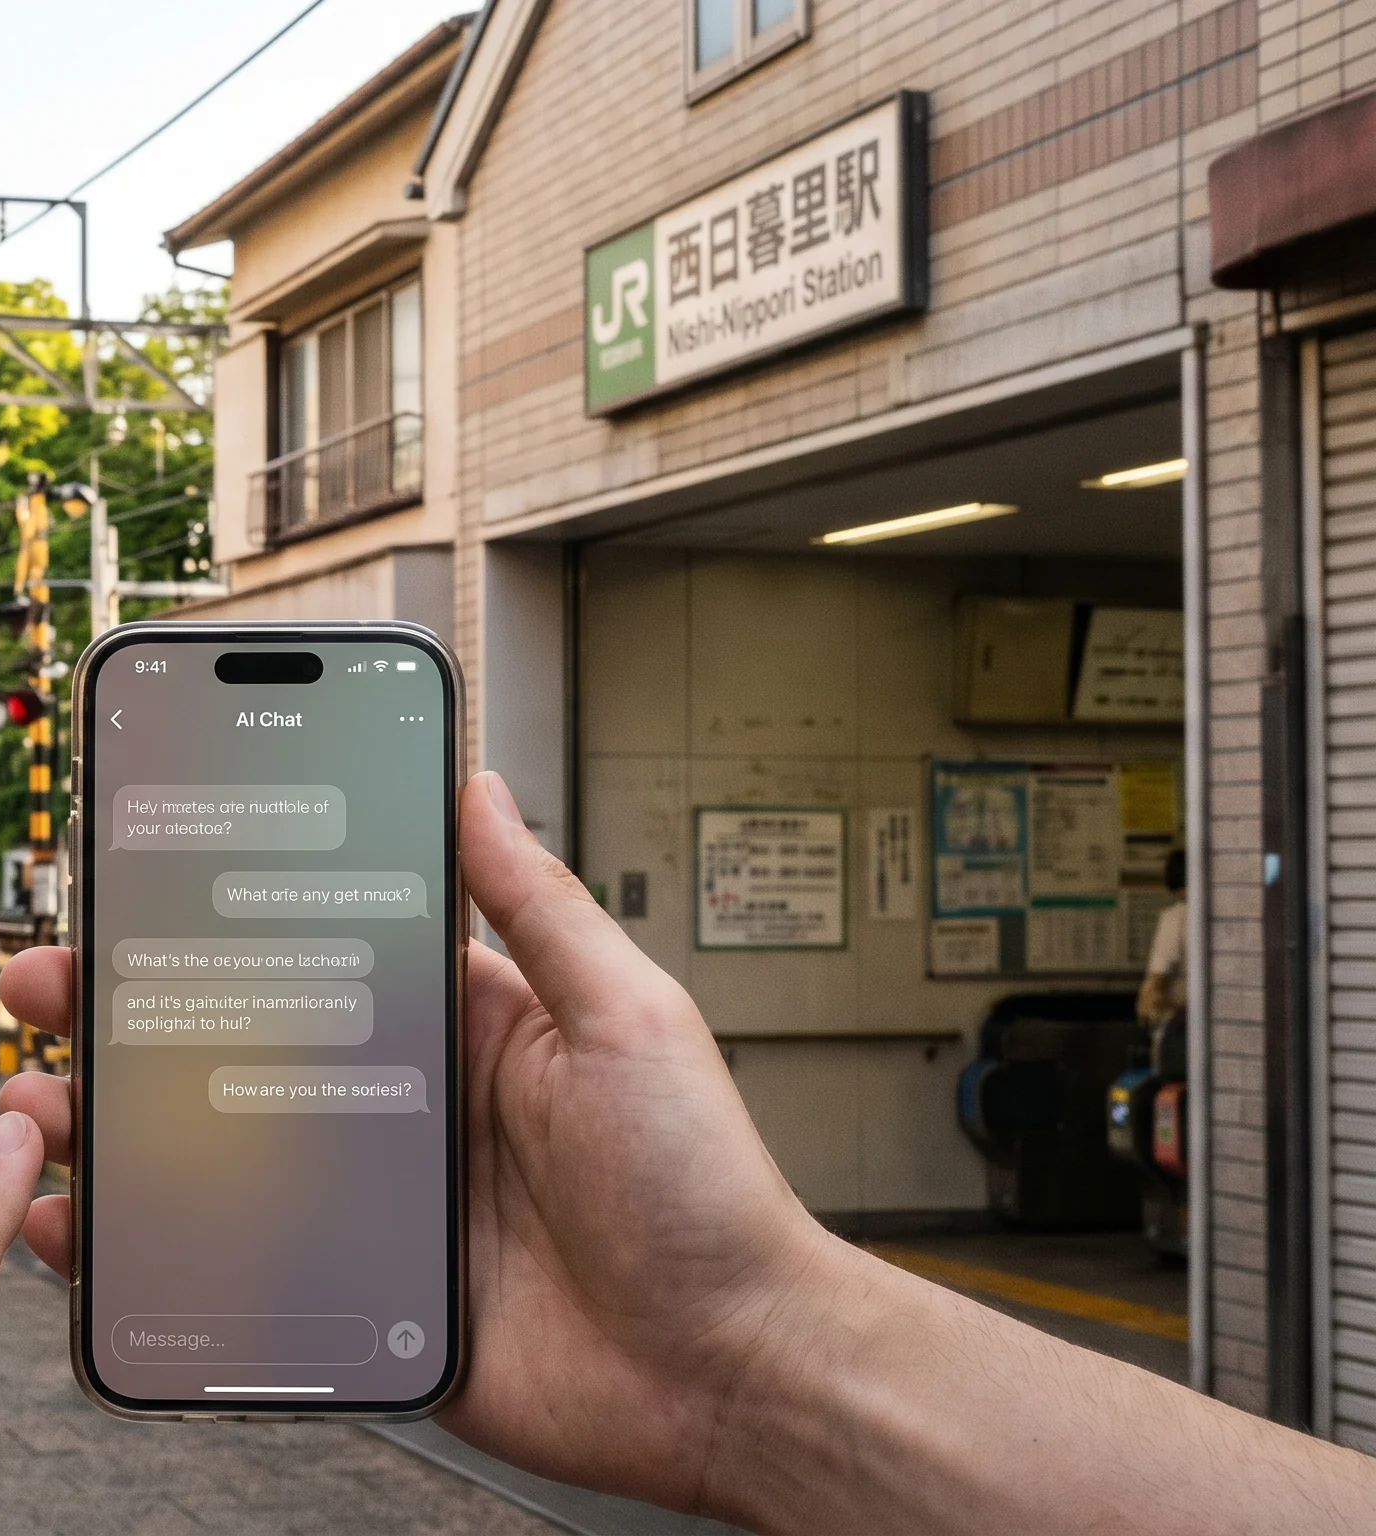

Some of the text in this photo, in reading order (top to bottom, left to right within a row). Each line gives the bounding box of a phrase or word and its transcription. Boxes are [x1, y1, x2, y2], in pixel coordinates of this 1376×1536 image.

[668, 139, 882, 305] 西日暮里駅
[592, 258, 649, 344] JR
[668, 275, 795, 356] Nishi-Nippori
[803, 249, 882, 306] Station
[134, 660, 167, 674] 9:41
[235, 711, 303, 728] AI Chat
[314, 799, 330, 814] of
[127, 823, 162, 838] your
[226, 887, 268, 902] What
[303, 890, 331, 905] any
[334, 888, 360, 905] get
[127, 953, 180, 968] What's
[184, 953, 209, 968] the
[127, 995, 156, 1009] and
[160, 995, 182, 1009] it's
[200, 1016, 216, 1030] to
[223, 1082, 258, 1097] How
[260, 1085, 285, 1097] are
[289, 1085, 317, 1100] you
[321, 1082, 347, 1097] the
[129, 1330, 225, 1351] Message...
